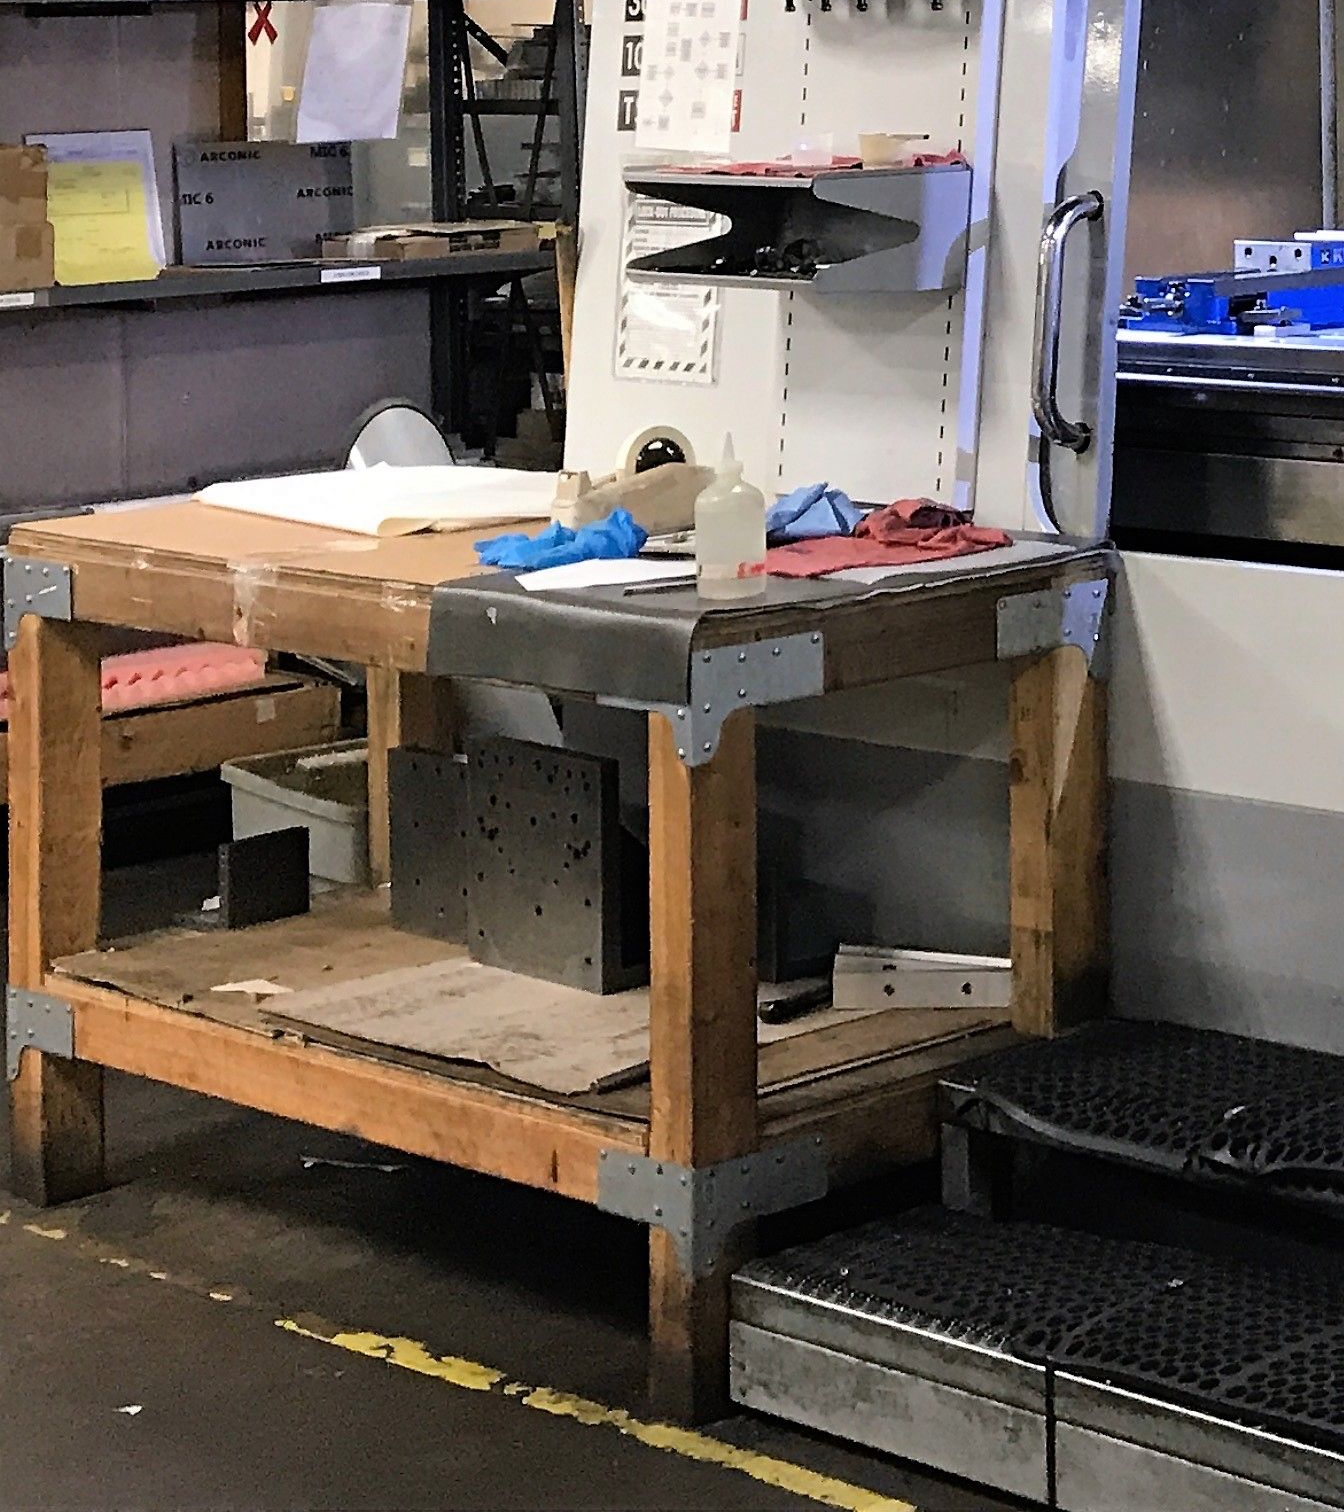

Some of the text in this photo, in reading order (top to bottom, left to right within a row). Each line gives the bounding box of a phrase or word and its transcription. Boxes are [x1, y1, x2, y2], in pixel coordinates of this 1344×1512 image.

[200, 150, 261, 162] ARCONIC
[206, 192, 214, 204] 6
[206, 238, 266, 251] ARCONIC
